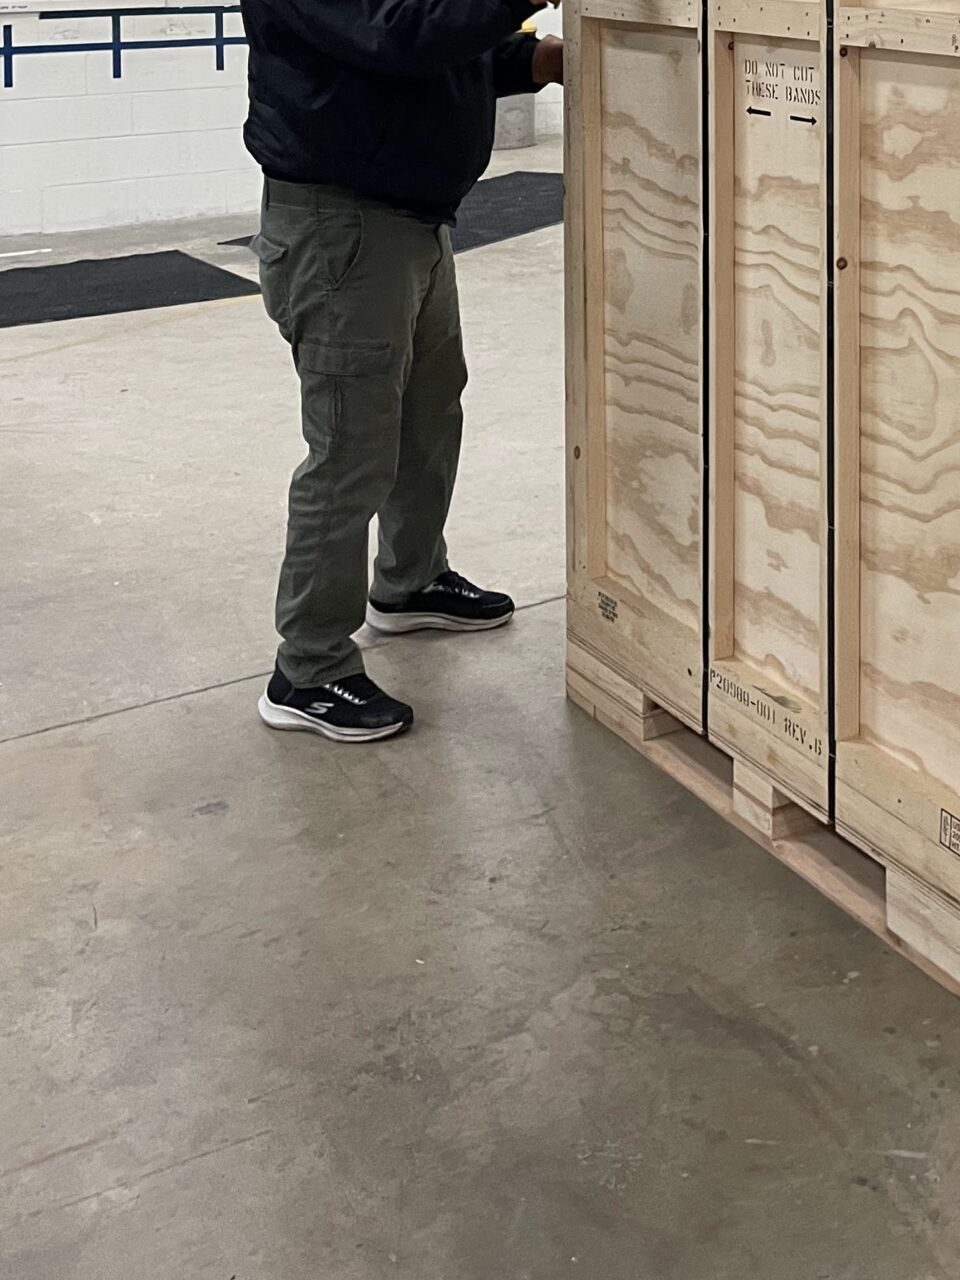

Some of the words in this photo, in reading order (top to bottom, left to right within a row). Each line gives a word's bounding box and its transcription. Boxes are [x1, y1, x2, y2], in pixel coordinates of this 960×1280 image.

[744, 59, 758, 76] DO
[765, 62, 786, 80] NOT
[793, 66, 815, 84] CUT
[745, 80, 778, 100] THESE
[785, 86, 821, 106] BANDS
